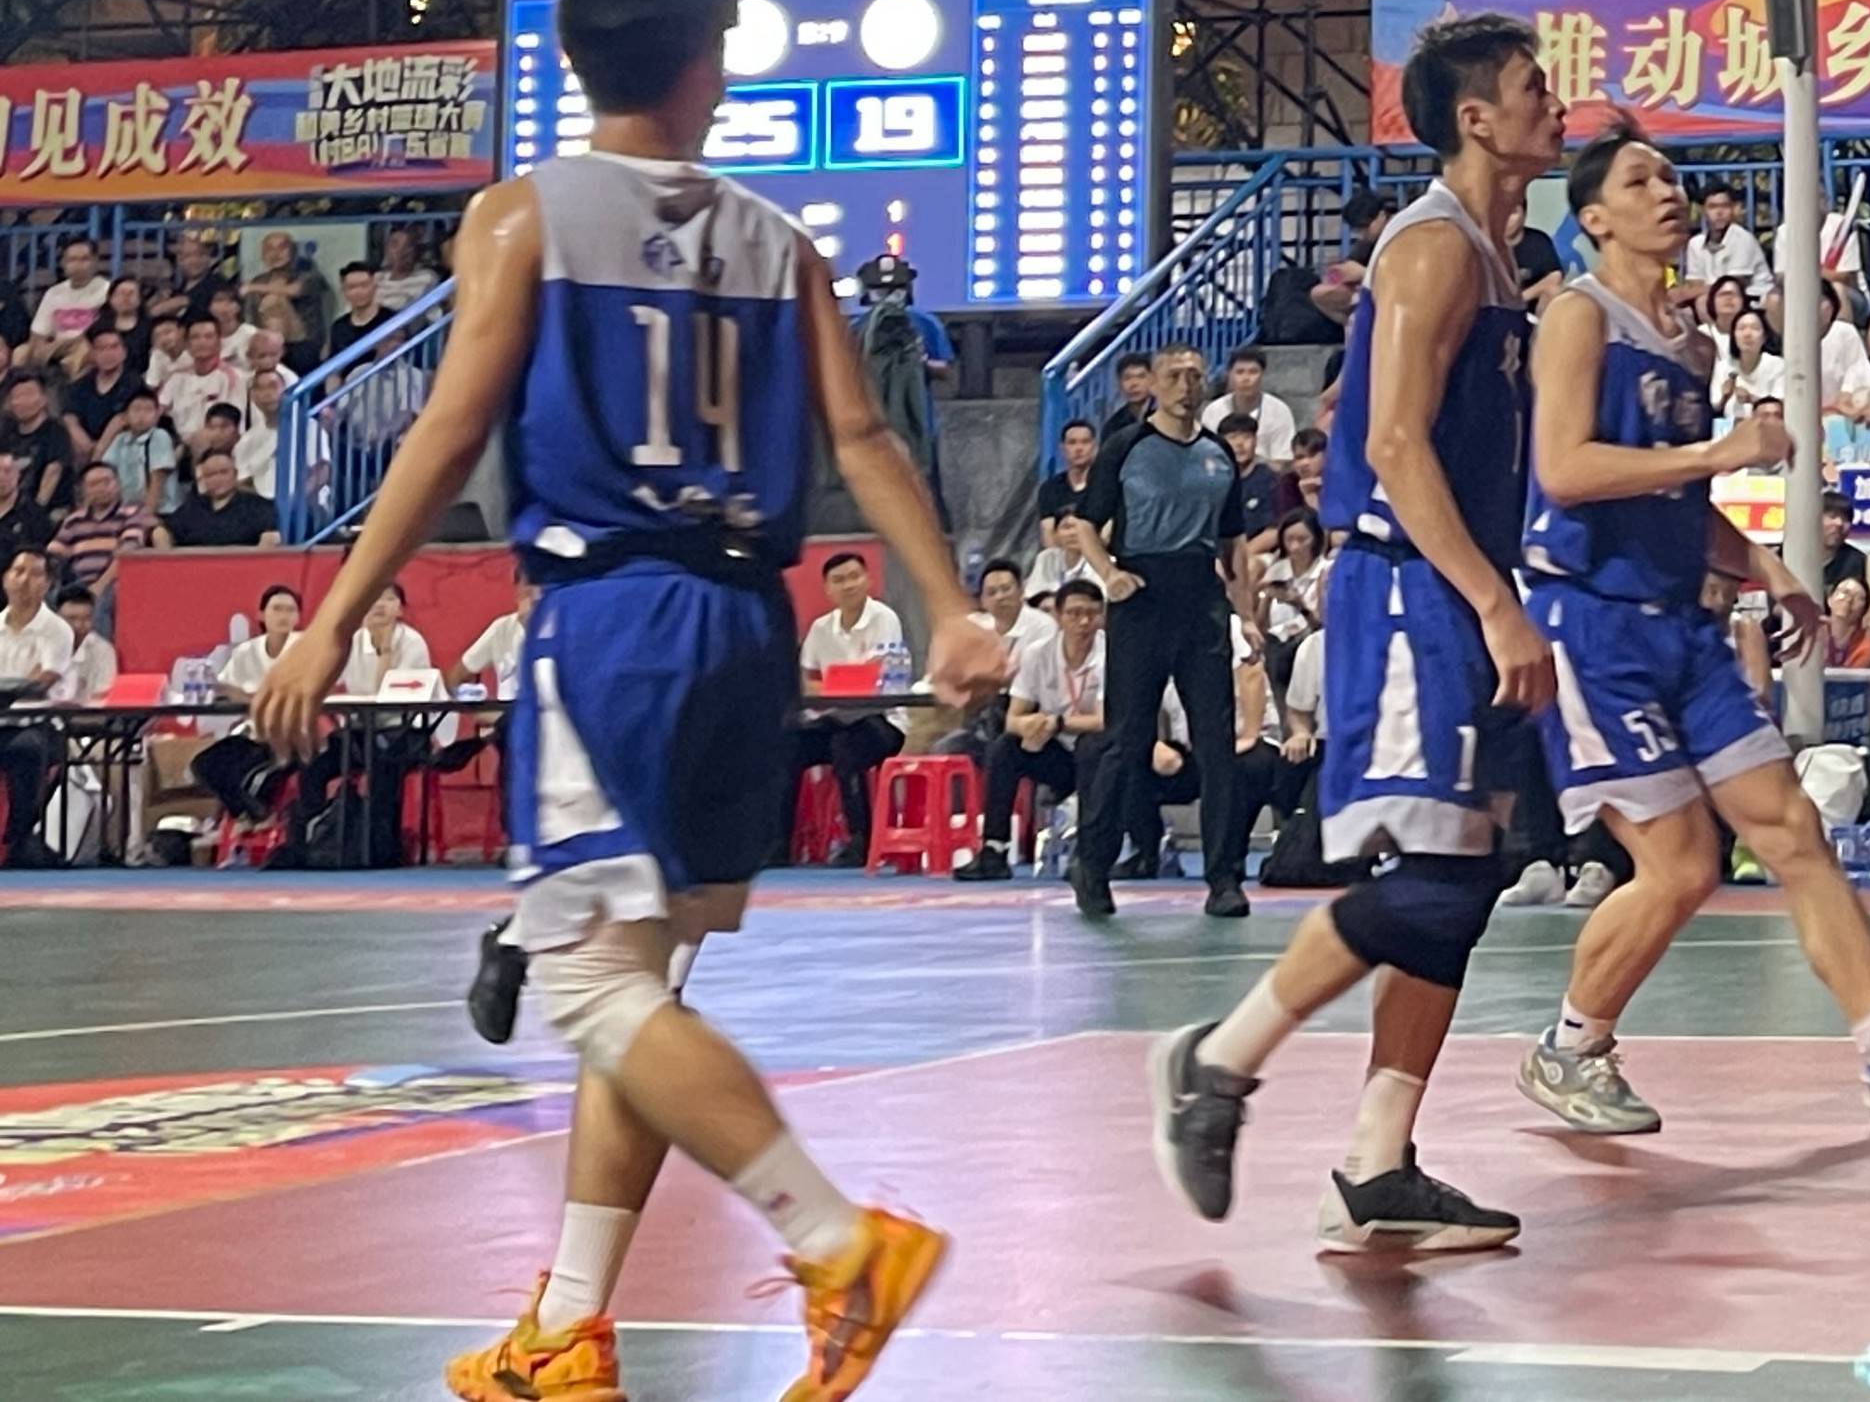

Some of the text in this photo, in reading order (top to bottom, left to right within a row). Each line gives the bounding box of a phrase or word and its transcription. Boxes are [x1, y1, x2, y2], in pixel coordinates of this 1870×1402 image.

[0, 77, 253, 181] 见成效
[703, 94, 936, 158] 25 19
[628, 304, 741, 473] 14
